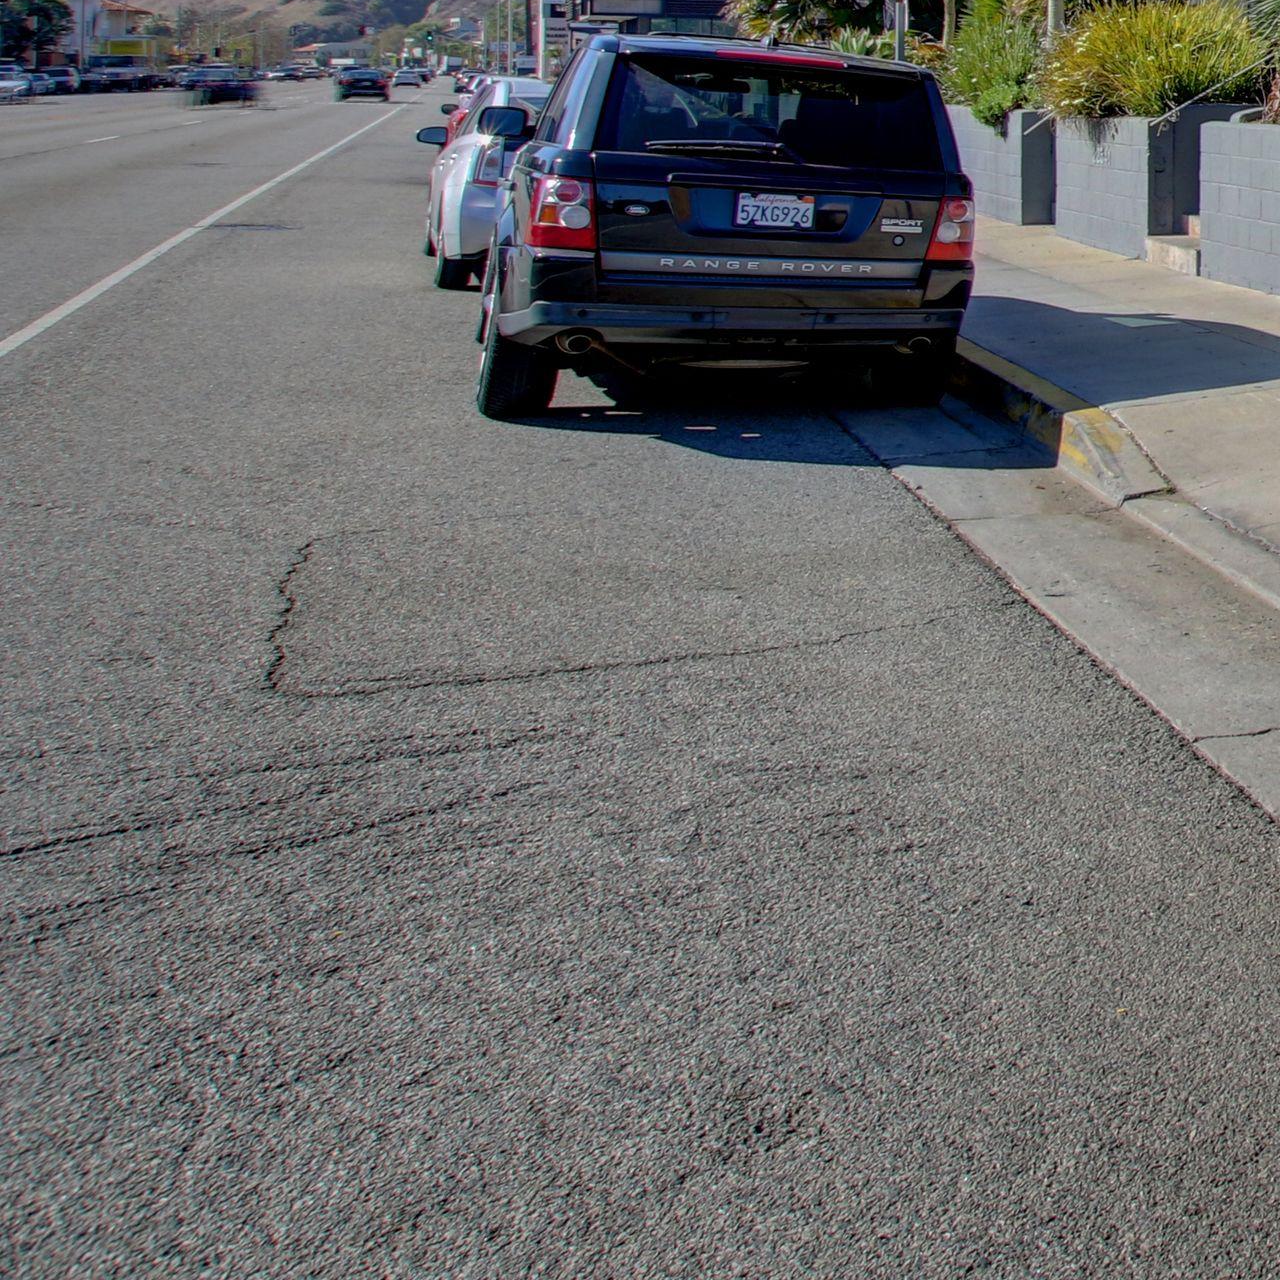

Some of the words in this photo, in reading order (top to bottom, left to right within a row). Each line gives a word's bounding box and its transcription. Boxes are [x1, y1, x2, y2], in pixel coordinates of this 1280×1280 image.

[740, 204, 810, 224] 5ZKG926
[881, 218, 924, 226] SPORT
[660, 258, 760, 271] RANGE
[781, 262, 872, 273] ROVER
